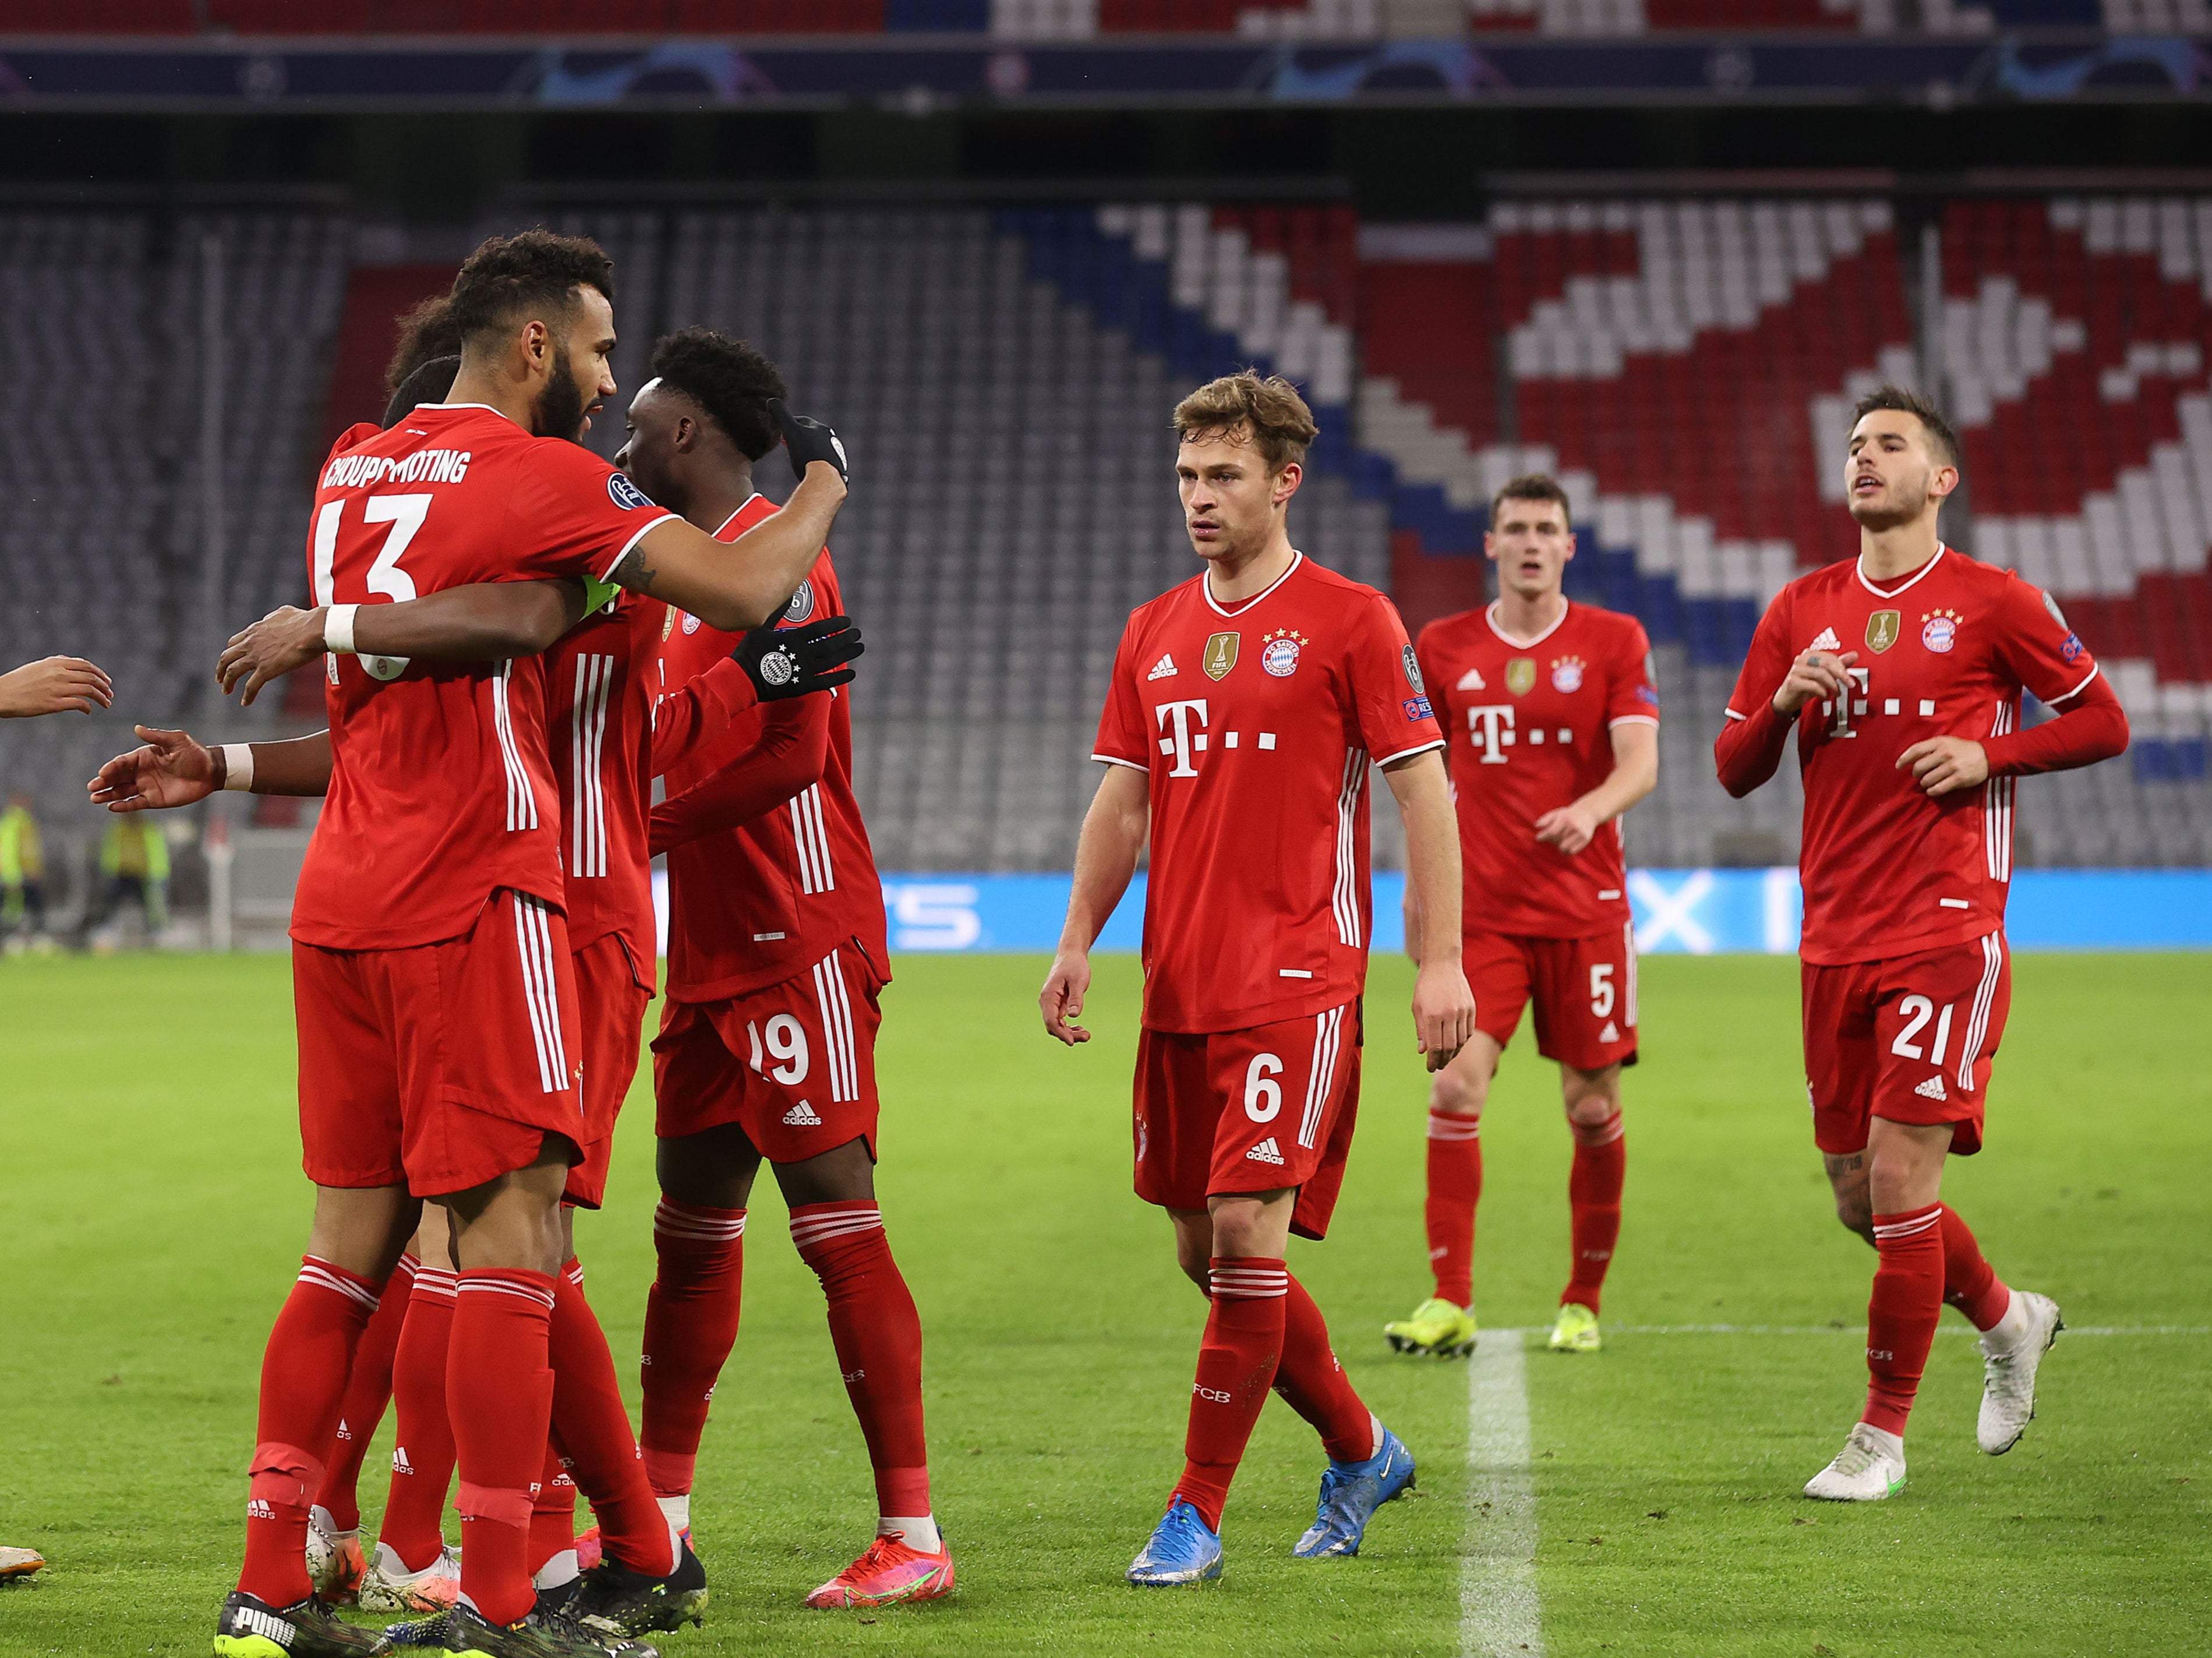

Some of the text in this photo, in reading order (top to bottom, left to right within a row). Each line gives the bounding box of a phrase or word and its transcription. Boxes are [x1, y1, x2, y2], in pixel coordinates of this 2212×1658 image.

[321, 449, 471, 489] CHOUPOMOTING
[314, 494, 434, 685] 13
[1589, 963, 1615, 1018] 5
[747, 1013, 810, 1086] 19
[1891, 994, 1955, 1066] 21
[1244, 1052, 1284, 1123] 6
[782, 1115, 822, 1126] adidas
[1246, 1150, 1285, 1165] adidas
[1193, 1383, 1231, 1404] FCB
[236, 1606, 296, 1648] PUMA
